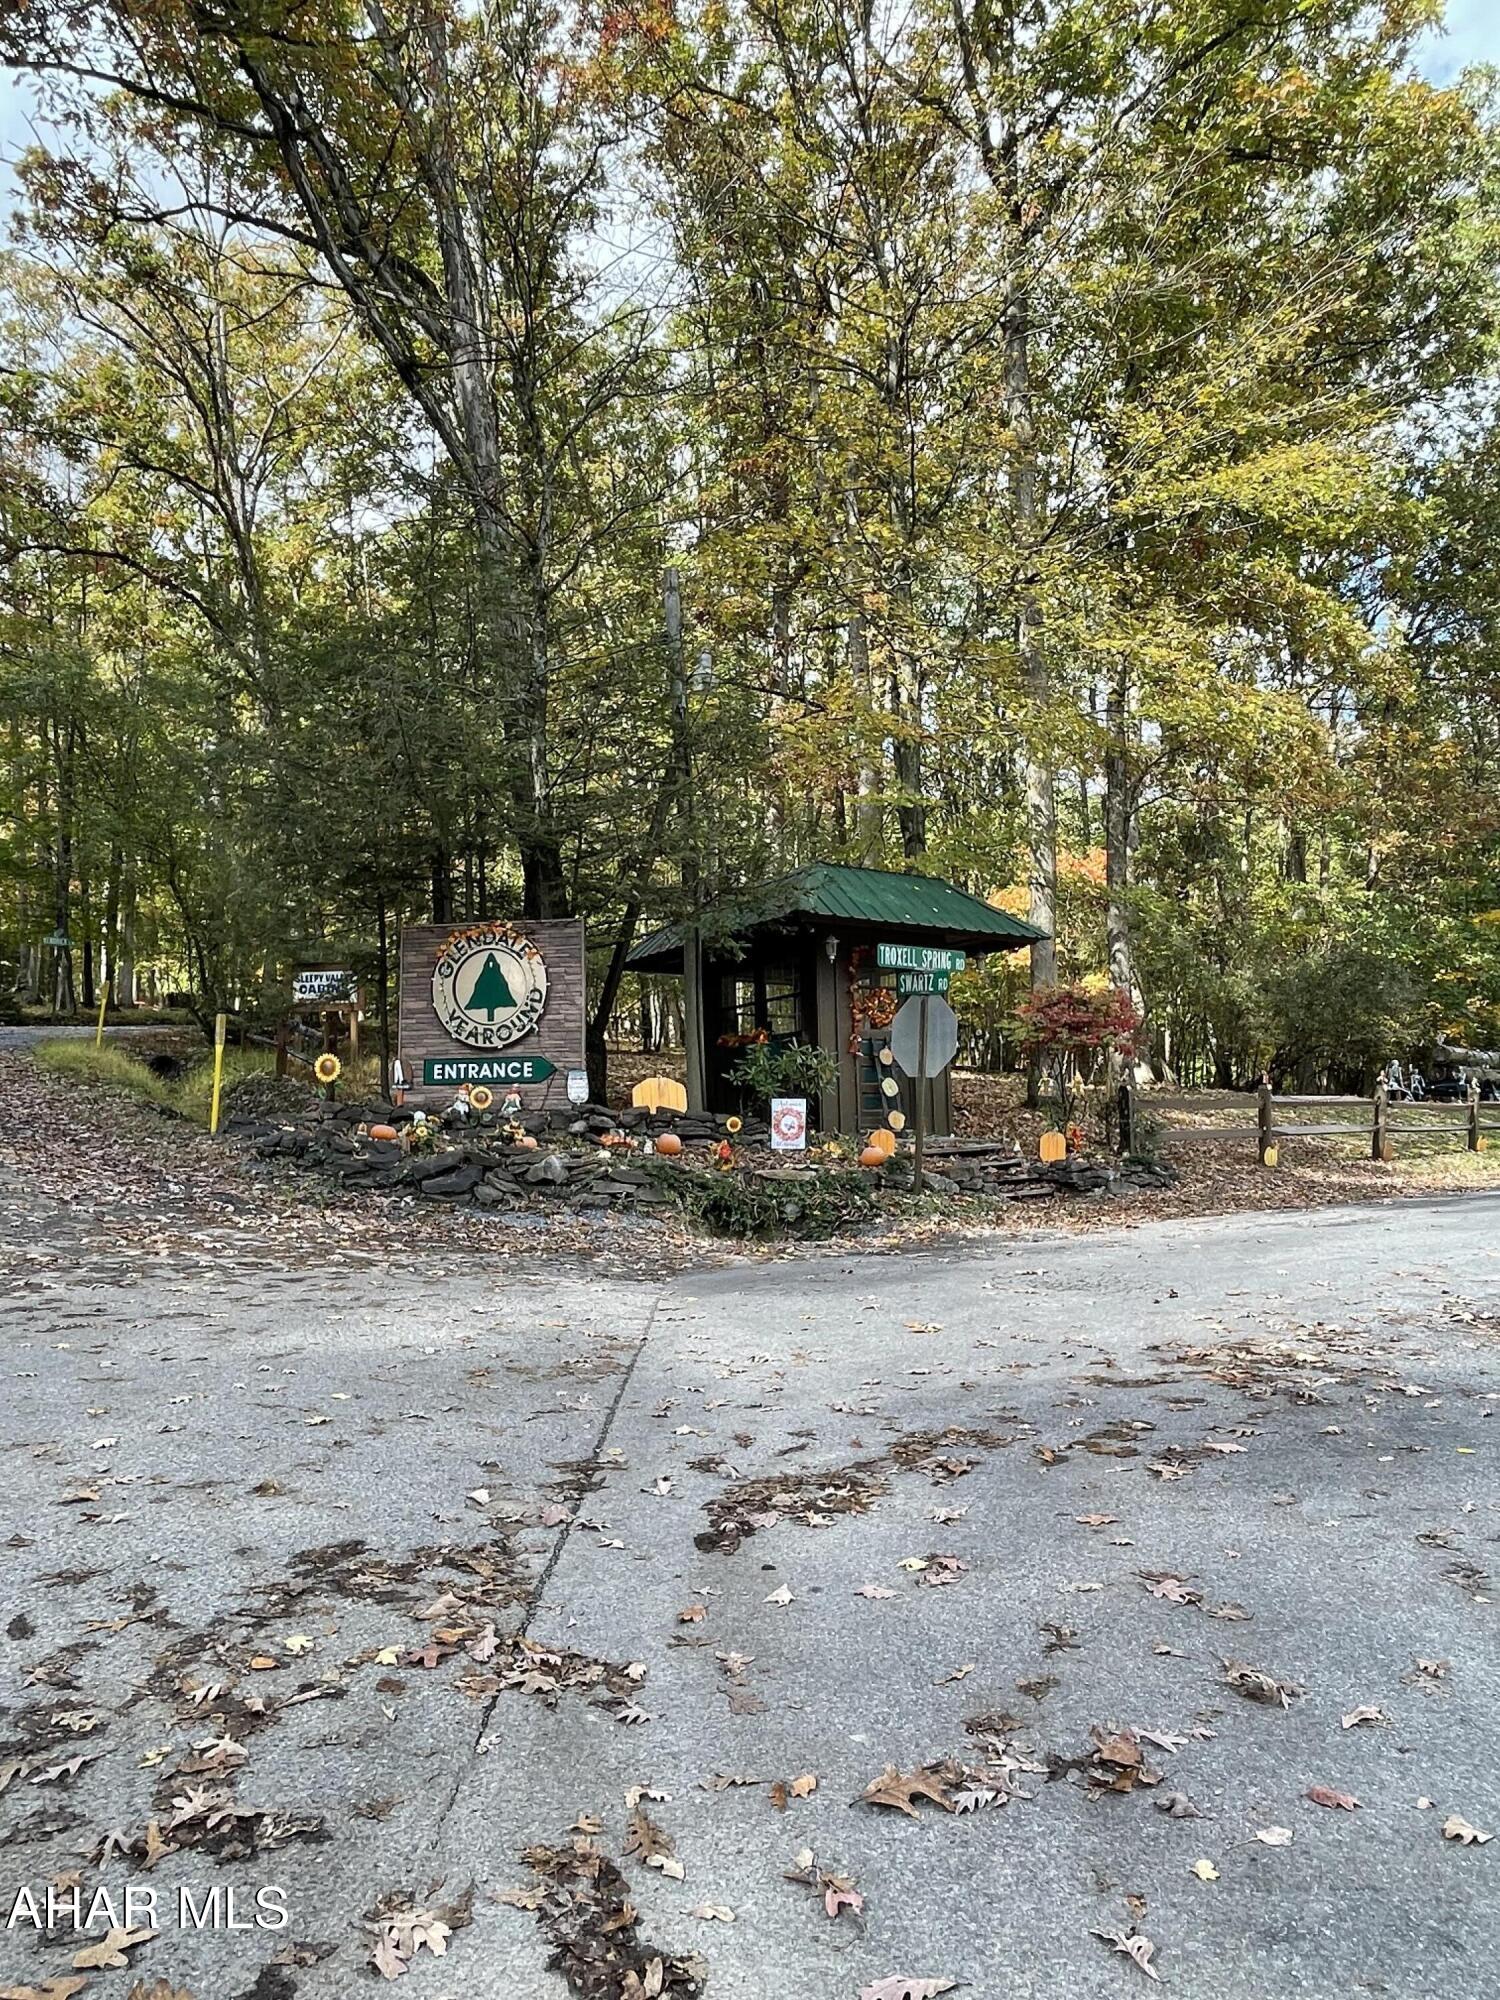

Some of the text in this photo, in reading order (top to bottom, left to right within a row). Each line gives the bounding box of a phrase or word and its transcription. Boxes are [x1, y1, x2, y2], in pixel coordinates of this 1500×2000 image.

[438, 931, 533, 978] GLENDALE
[879, 946, 965, 971] TROXELL SPRING RD
[295, 974, 324, 983] SLEEPY
[900, 973, 948, 993] SWARTZ RD
[445, 988, 543, 1044] YEAROUND
[433, 1061, 533, 1080] ENTRANCE
